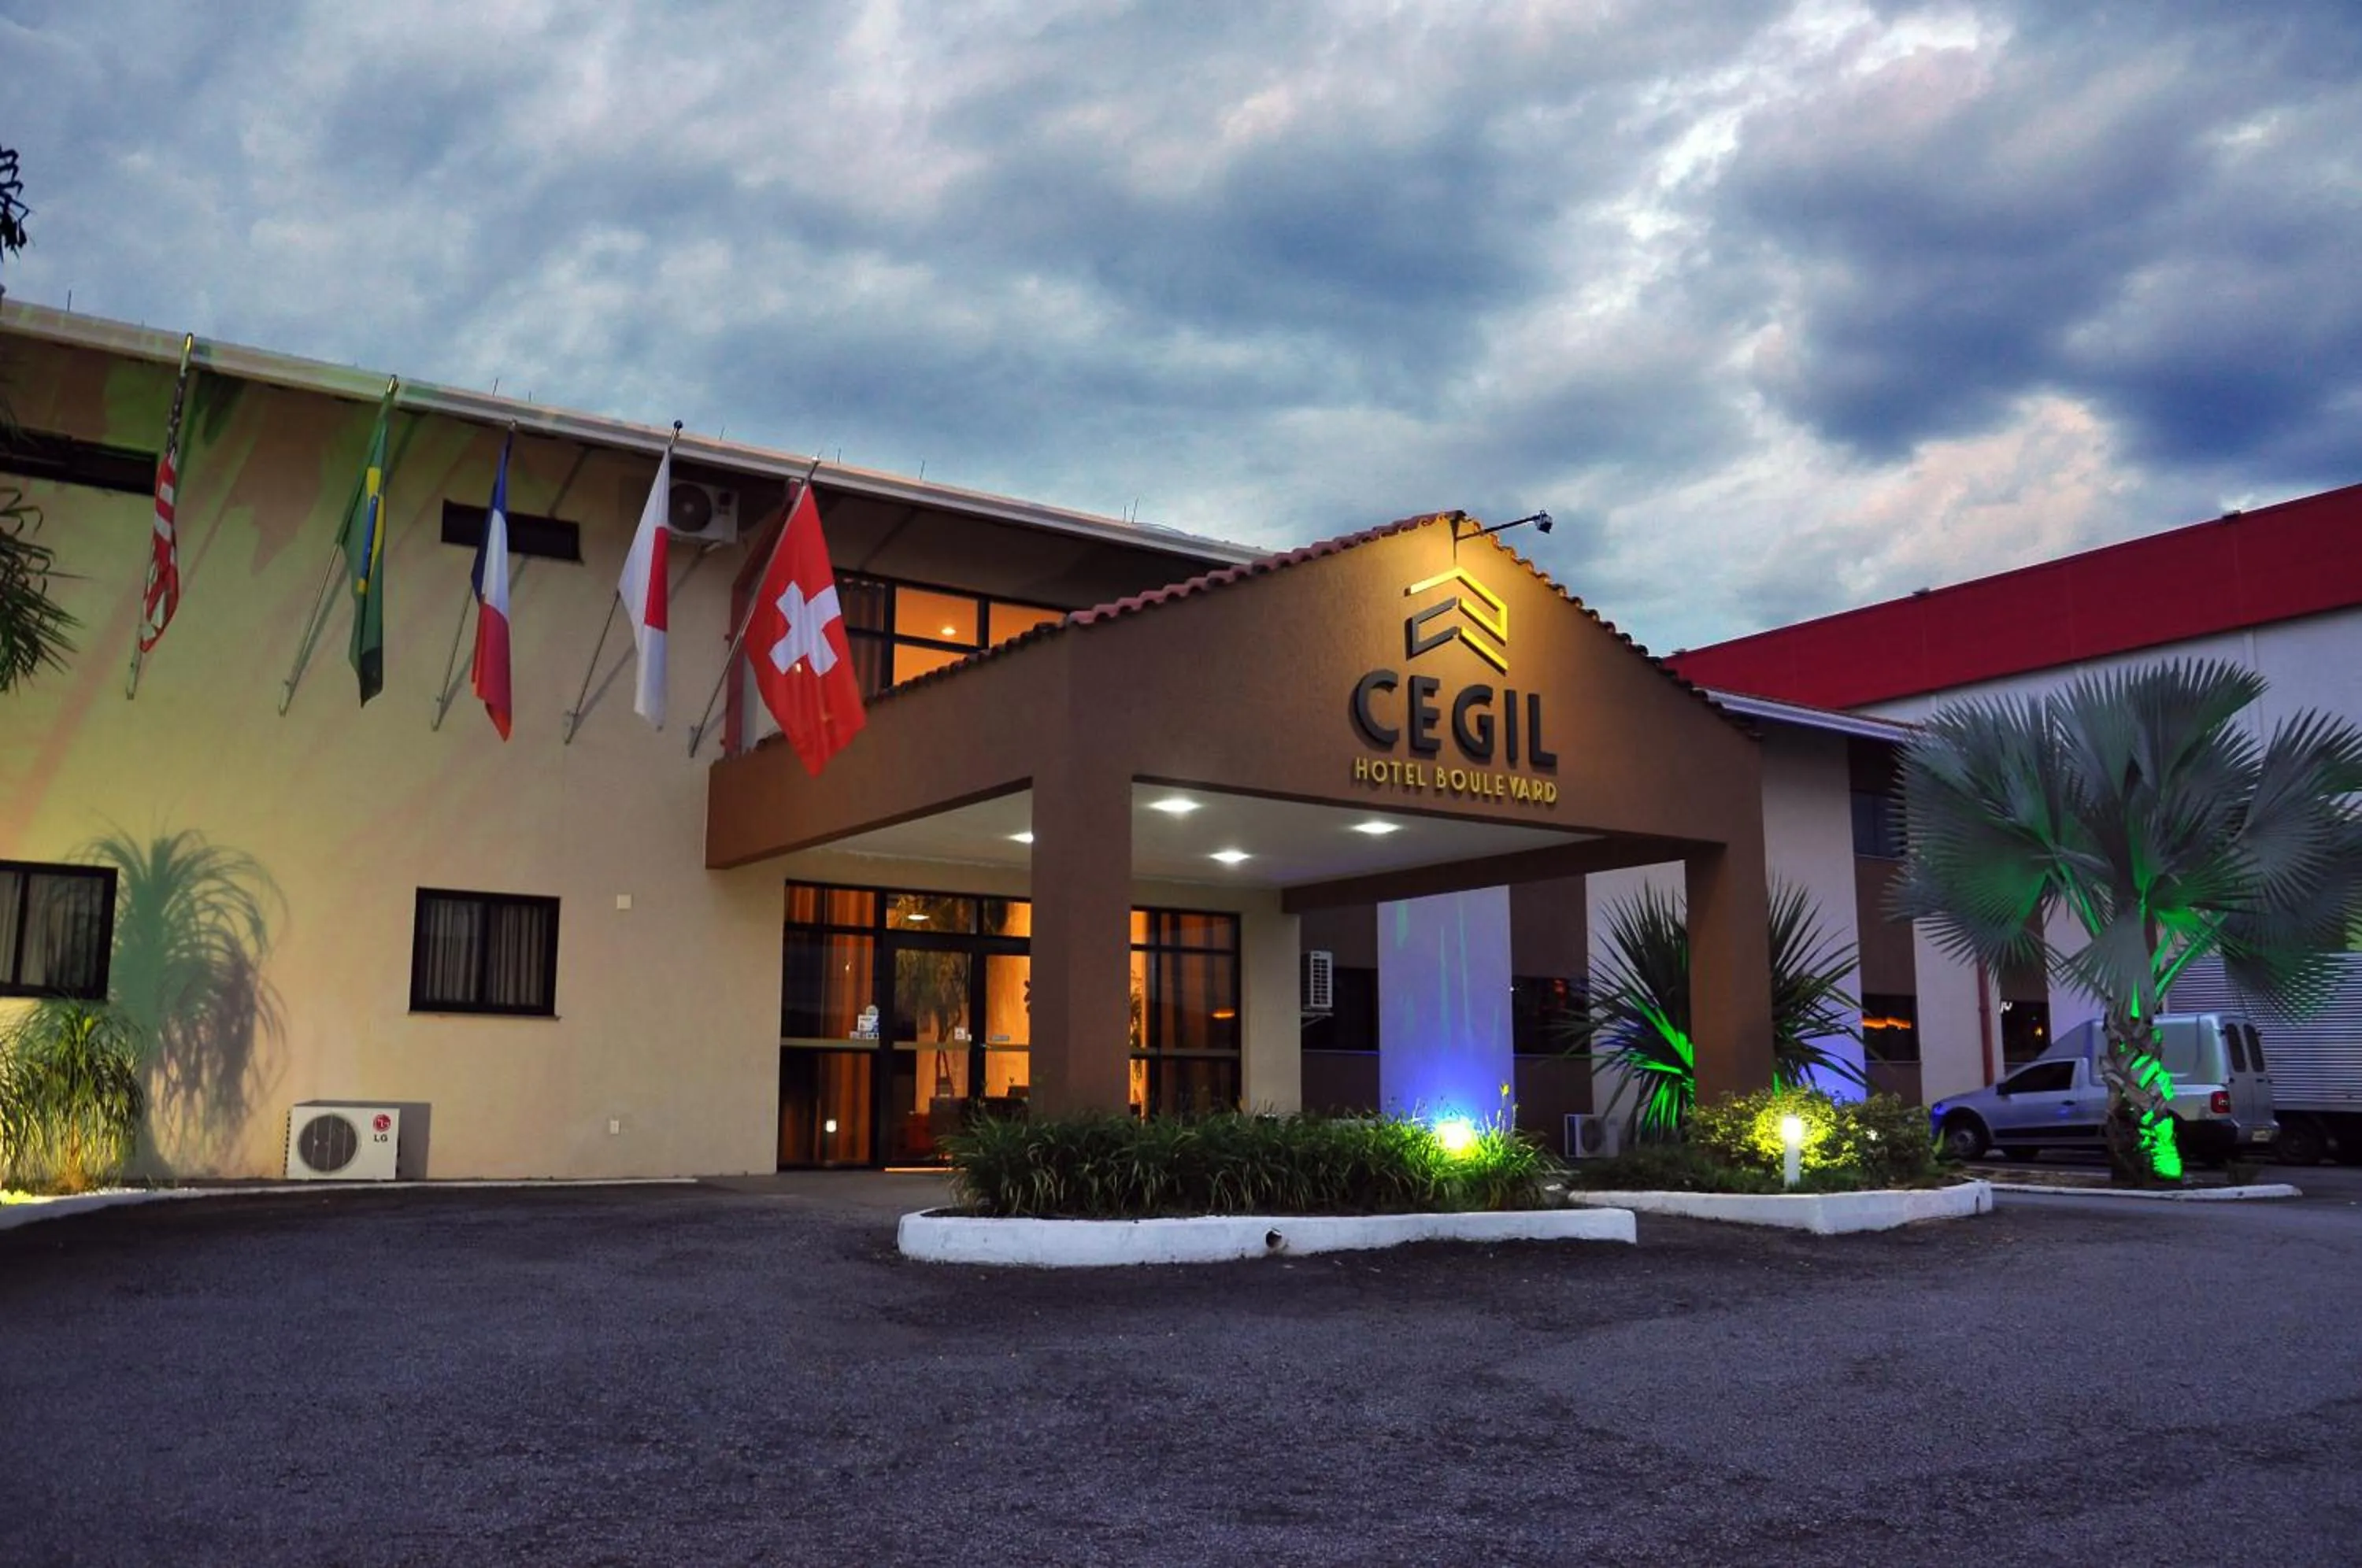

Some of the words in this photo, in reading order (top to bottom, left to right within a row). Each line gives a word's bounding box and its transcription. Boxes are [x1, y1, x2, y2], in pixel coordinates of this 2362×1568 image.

[1352, 669, 1557, 770] CEGIL
[1354, 756, 1427, 787] HOTEL
[1435, 766, 1558, 804] BOULEVARD
[373, 1133, 388, 1143] LG
